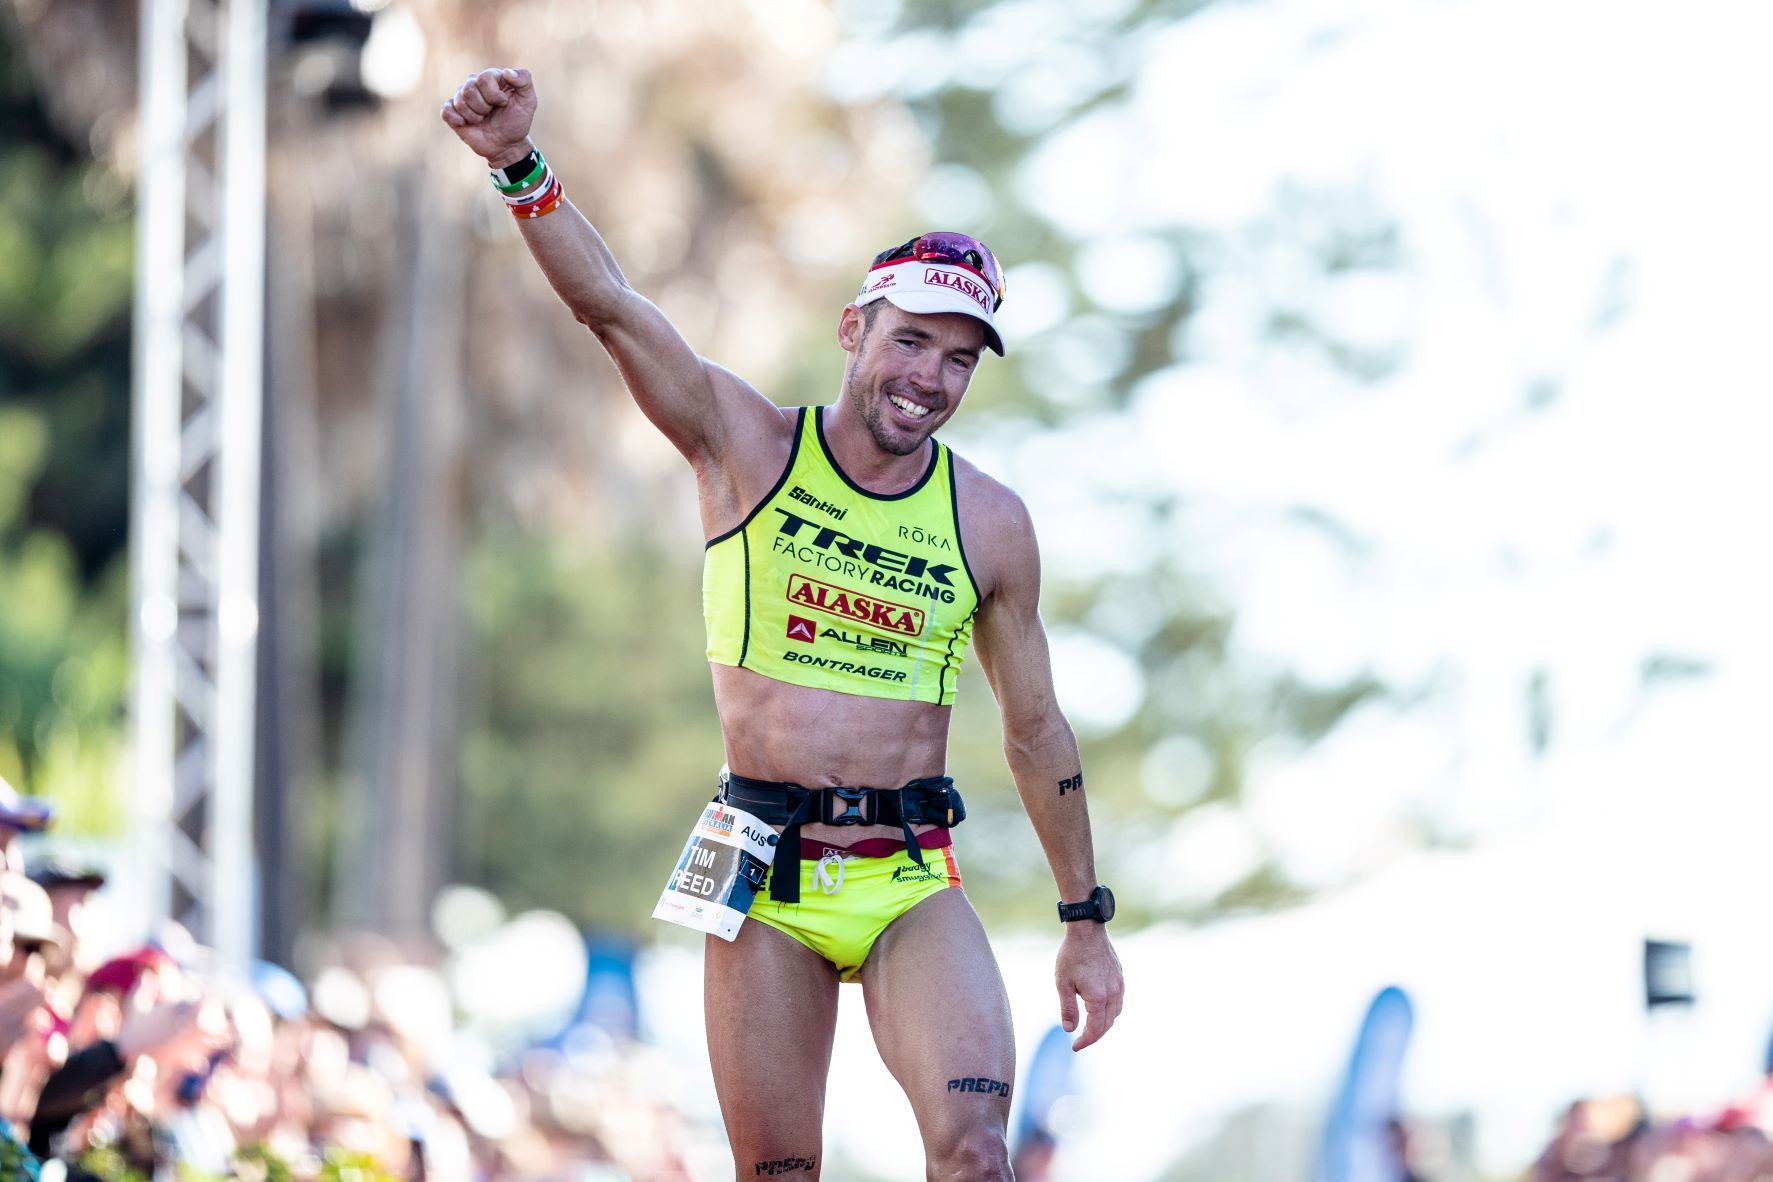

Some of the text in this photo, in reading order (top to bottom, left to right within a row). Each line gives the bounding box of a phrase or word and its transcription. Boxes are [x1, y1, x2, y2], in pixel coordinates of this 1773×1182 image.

[928, 272, 987, 309] ALASKA
[788, 486, 848, 521] Santini
[775, 507, 958, 587] TREK
[773, 536, 955, 604] FACTORY RACING
[792, 582, 915, 632] ALASKA
[819, 628, 907, 654] ALLEN
[783, 651, 907, 682] BONTRAGER
[741, 826, 766, 847] AUS
[684, 846, 716, 870] TIM
[750, 868, 756, 876] 1
[672, 869, 715, 896] REED
